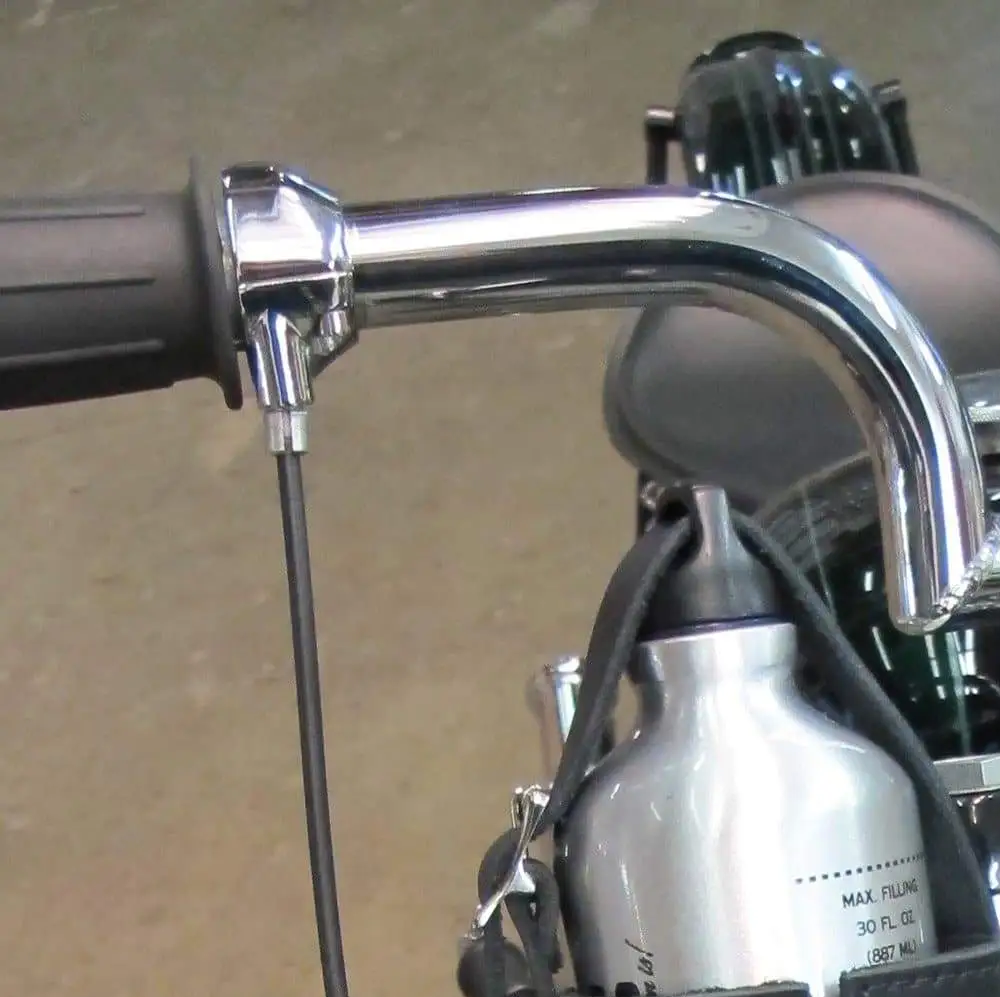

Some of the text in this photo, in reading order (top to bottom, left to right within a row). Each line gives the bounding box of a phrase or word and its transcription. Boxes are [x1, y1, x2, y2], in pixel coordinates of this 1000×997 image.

[842, 878, 918, 908] MAX. FILLING
[856, 919, 877, 936] 30
[867, 939, 917, 966] (887 ML)
